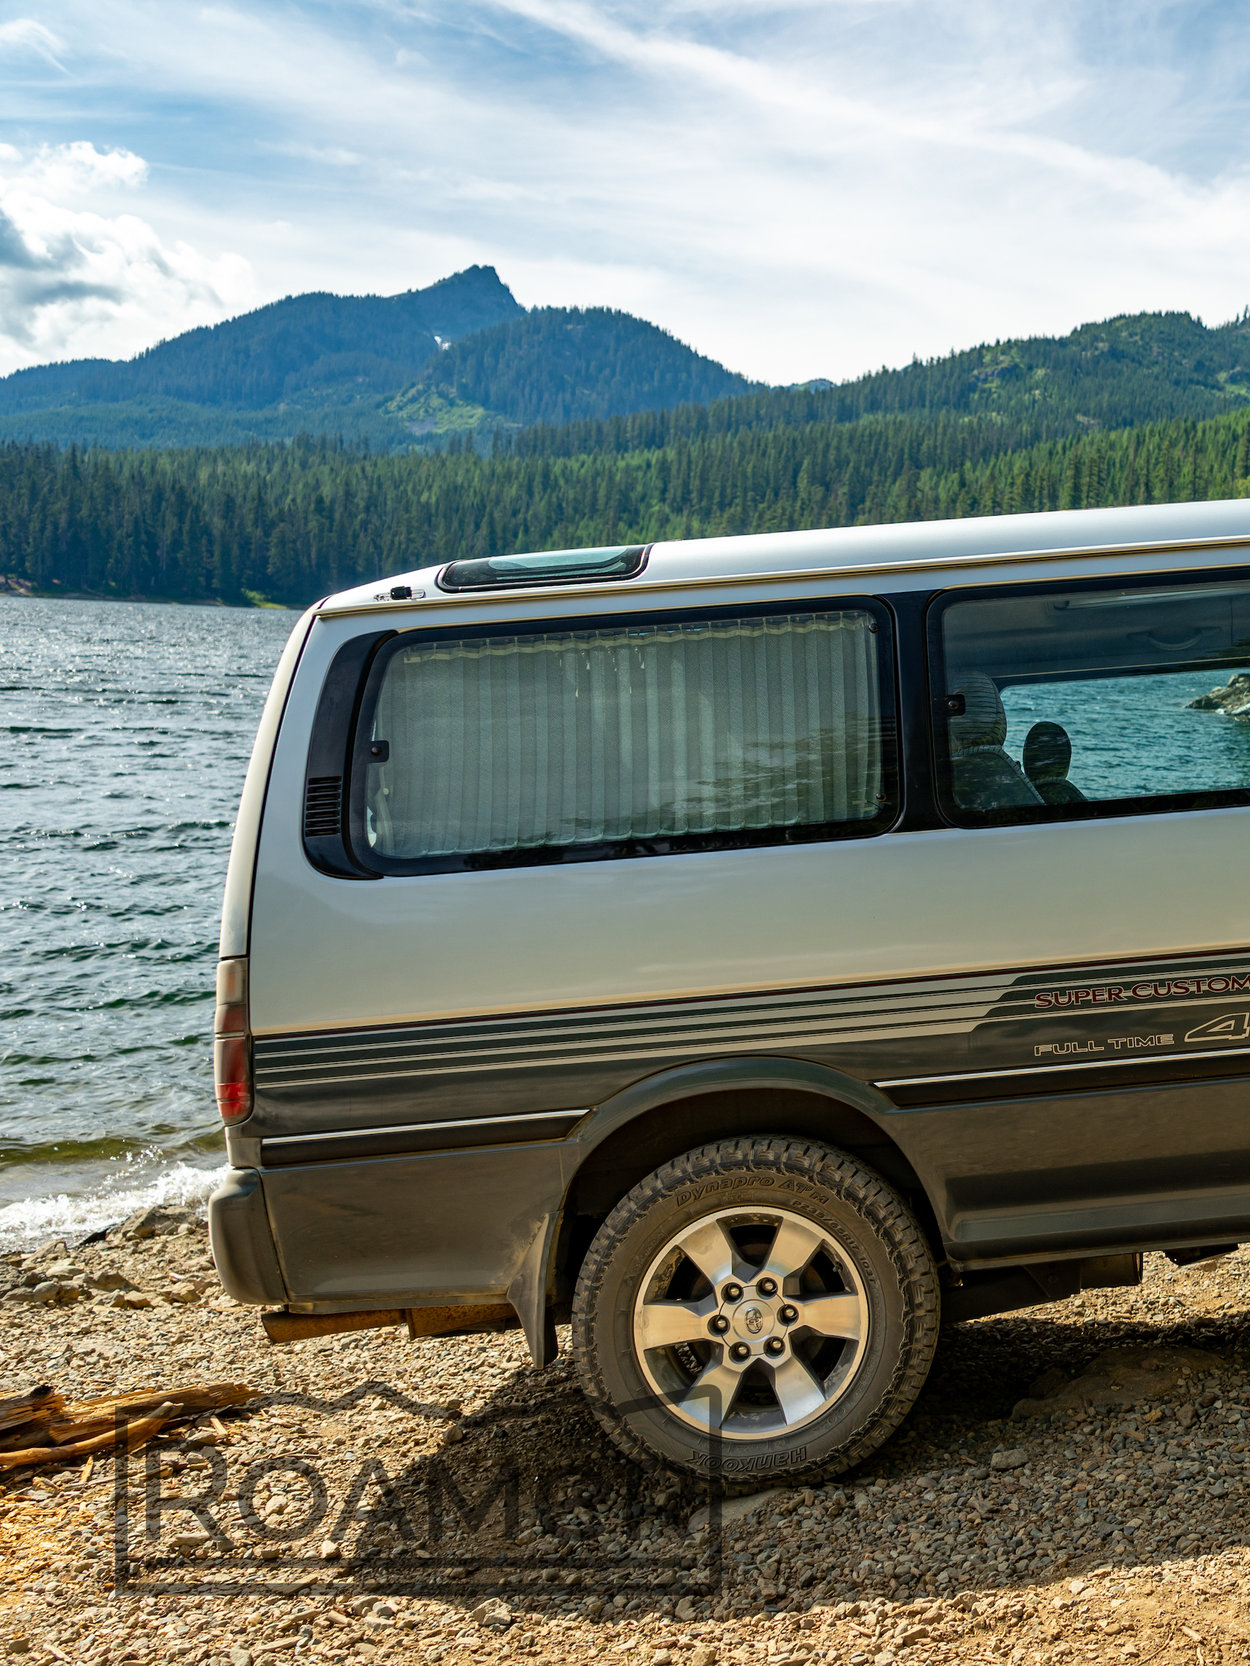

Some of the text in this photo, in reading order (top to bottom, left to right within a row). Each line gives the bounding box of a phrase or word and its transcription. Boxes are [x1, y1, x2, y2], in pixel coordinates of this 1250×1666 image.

[1034, 986, 1125, 1009] SUPER
[1033, 1040, 1105, 1057] FULL
[1107, 1033, 1175, 1050] TIME
[676, 1176, 776, 1207] Dynapro
